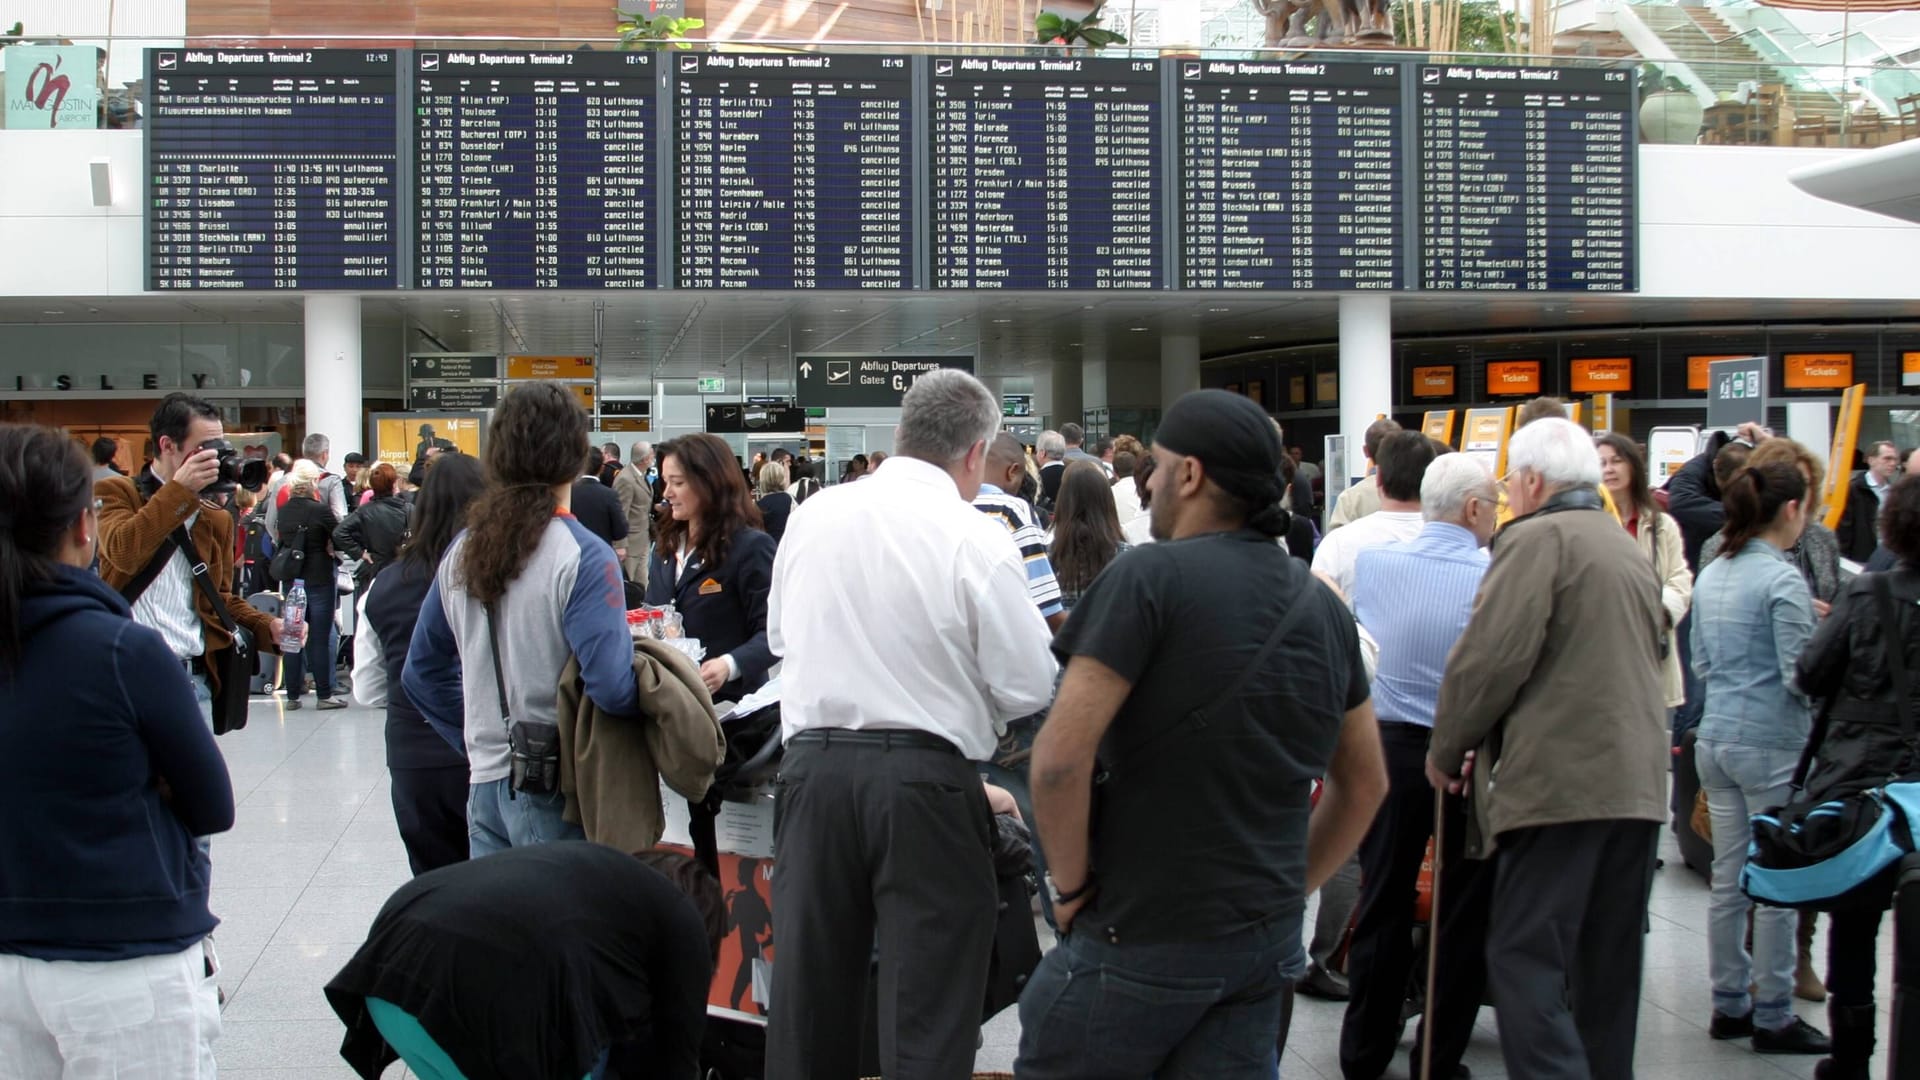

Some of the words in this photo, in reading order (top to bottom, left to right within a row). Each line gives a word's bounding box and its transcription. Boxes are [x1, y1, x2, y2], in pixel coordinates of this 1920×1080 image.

[185, 52, 214, 64] Abflug
[218, 52, 264, 64] Departures
[268, 52, 304, 62] Terminal
[306, 53, 312, 62] 2
[366, 54, 388, 62] 12:43
[448, 54, 475, 65] Abflug
[480, 54, 525, 65] Departures
[530, 54, 565, 64] Terminal
[567, 54, 573, 64] 2
[626, 56, 647, 64] 12:43
[707, 56, 734, 68] Abflug
[739, 57, 783, 68] Departures
[787, 57, 822, 67] Terminal
[824, 58, 830, 67] 2
[961, 59, 988, 71] Abflug
[992, 60, 1035, 72] Departures
[1040, 61, 1073, 70] Terminal
[1076, 62, 1081, 71] 2
[1209, 63, 1234, 75] Abflug
[1239, 64, 1281, 75] Departures
[1285, 64, 1318, 74] Terminal
[1319, 65, 1325, 74] 2
[1447, 68, 1472, 80] Abflug
[1476, 70, 1516, 80] Departures
[1520, 70, 1551, 79] Terminal
[1552, 71, 1558, 80] 2
[159, 95, 172, 104] Auf
[536, 108, 557, 116] 13:10
[937, 112, 945, 120] LH
[975, 112, 996, 120] Turin
[1046, 113, 1066, 122] 14:55
[720, 121, 737, 130] Linz
[536, 142, 557, 150] 13:15
[422, 153, 430, 162] LH
[461, 153, 491, 162] Cologne
[301, 164, 322, 172] 13:45
[937, 168, 946, 176] LH
[975, 168, 1004, 176] Dresden
[422, 176, 431, 184] LH
[461, 176, 491, 184] Trieste
[682, 177, 690, 186] LH
[794, 178, 814, 186] 14:45
[1222, 181, 1255, 190] Brussels
[199, 199, 235, 208] Lissabon
[275, 199, 296, 208] 12:55
[860, 361, 889, 372] Abflug
[892, 361, 939, 372] Departures
[1804, 368, 1838, 376] Tickets
[860, 375, 885, 385] Gates
[380, 450, 409, 460] Airport
